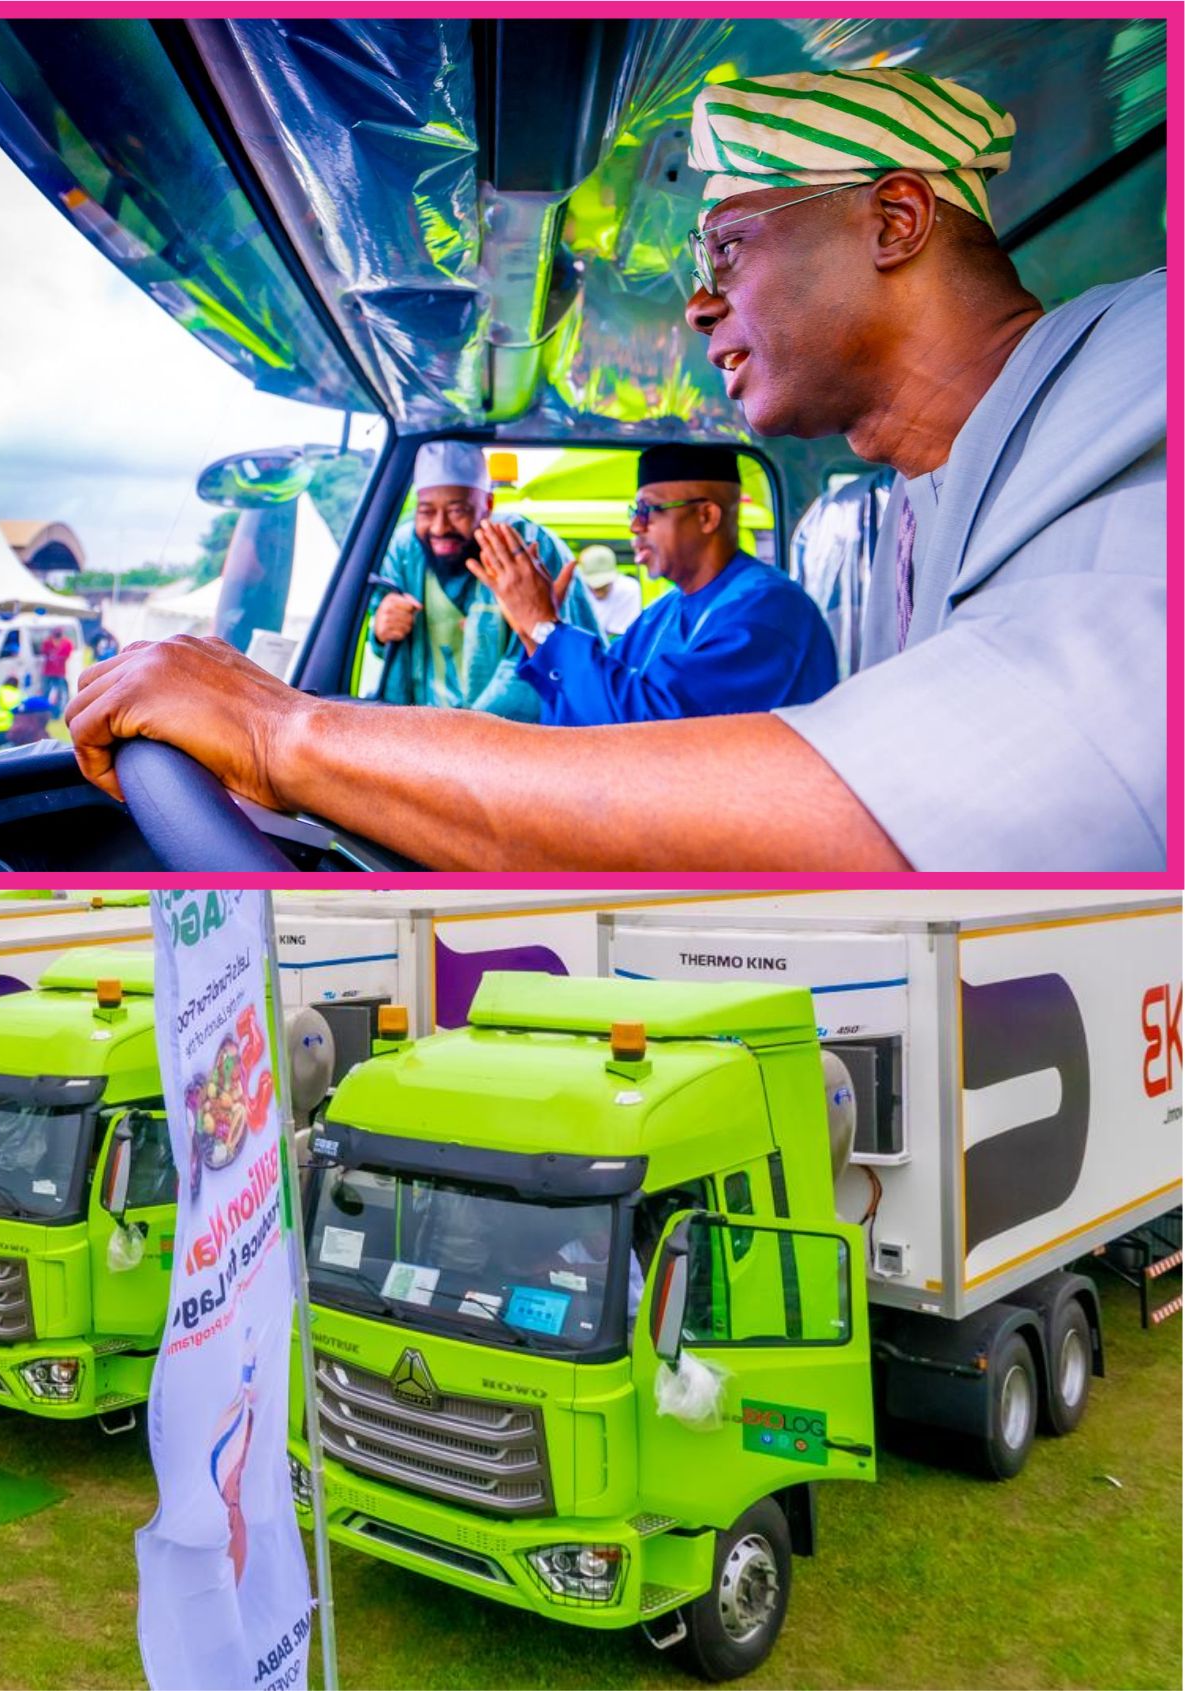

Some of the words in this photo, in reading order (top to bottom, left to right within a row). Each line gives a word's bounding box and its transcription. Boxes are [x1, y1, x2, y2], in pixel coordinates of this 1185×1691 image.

[279, 935, 306, 945] KING
[680, 953, 743, 968] THERMO
[747, 958, 786, 970] KING
